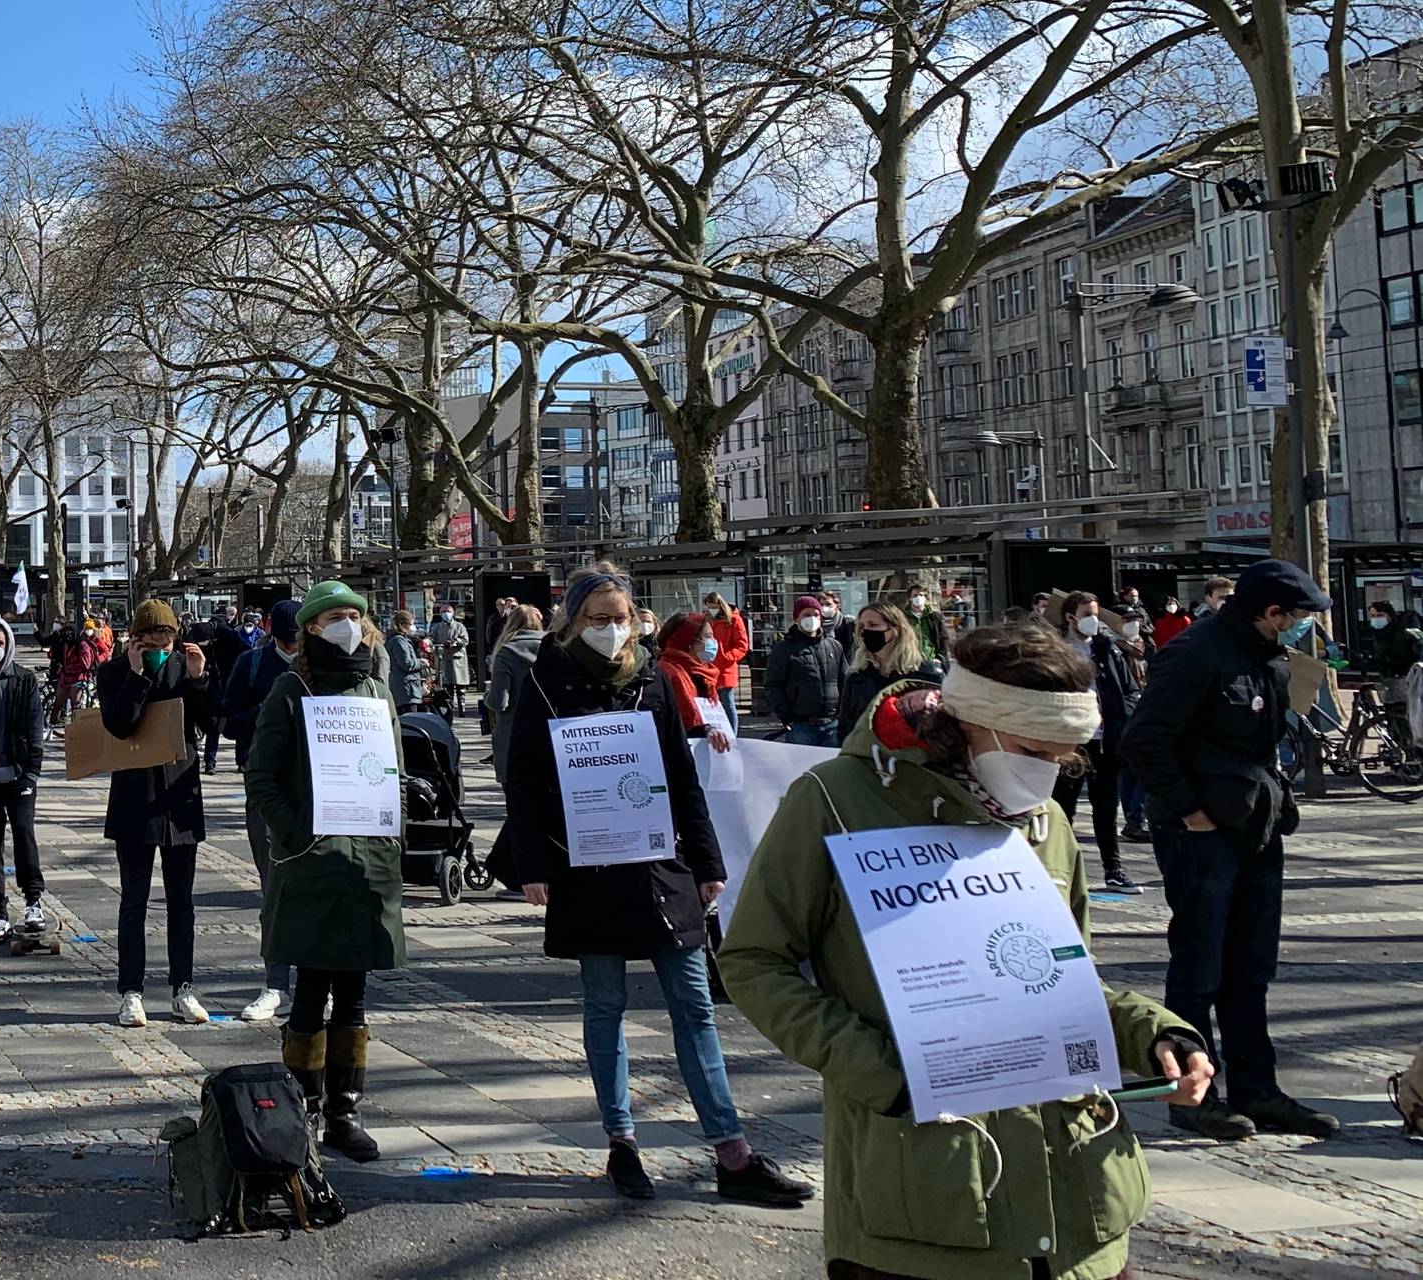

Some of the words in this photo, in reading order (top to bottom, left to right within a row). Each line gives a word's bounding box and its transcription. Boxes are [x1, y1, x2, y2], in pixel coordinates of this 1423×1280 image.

[313, 706, 325, 716] IN
[327, 706, 347, 716] MIR
[315, 719, 346, 730] NOCH
[348, 719, 363, 730] SO
[364, 721, 383, 732] VIEL
[561, 723, 635, 739] MITREISSEN
[317, 733, 364, 745] ENERGIE!
[564, 741, 601, 754] STATT
[568, 752, 640, 769] ABREISSEN!
[632, 796, 655, 810] FUTURE
[855, 848, 906, 874] ICH
[908, 841, 960, 867] BIN
[869, 879, 959, 912] NOCH
[985, 921, 1025, 978] ARCHITECTS
[1024, 966, 1065, 995] FUTURE
